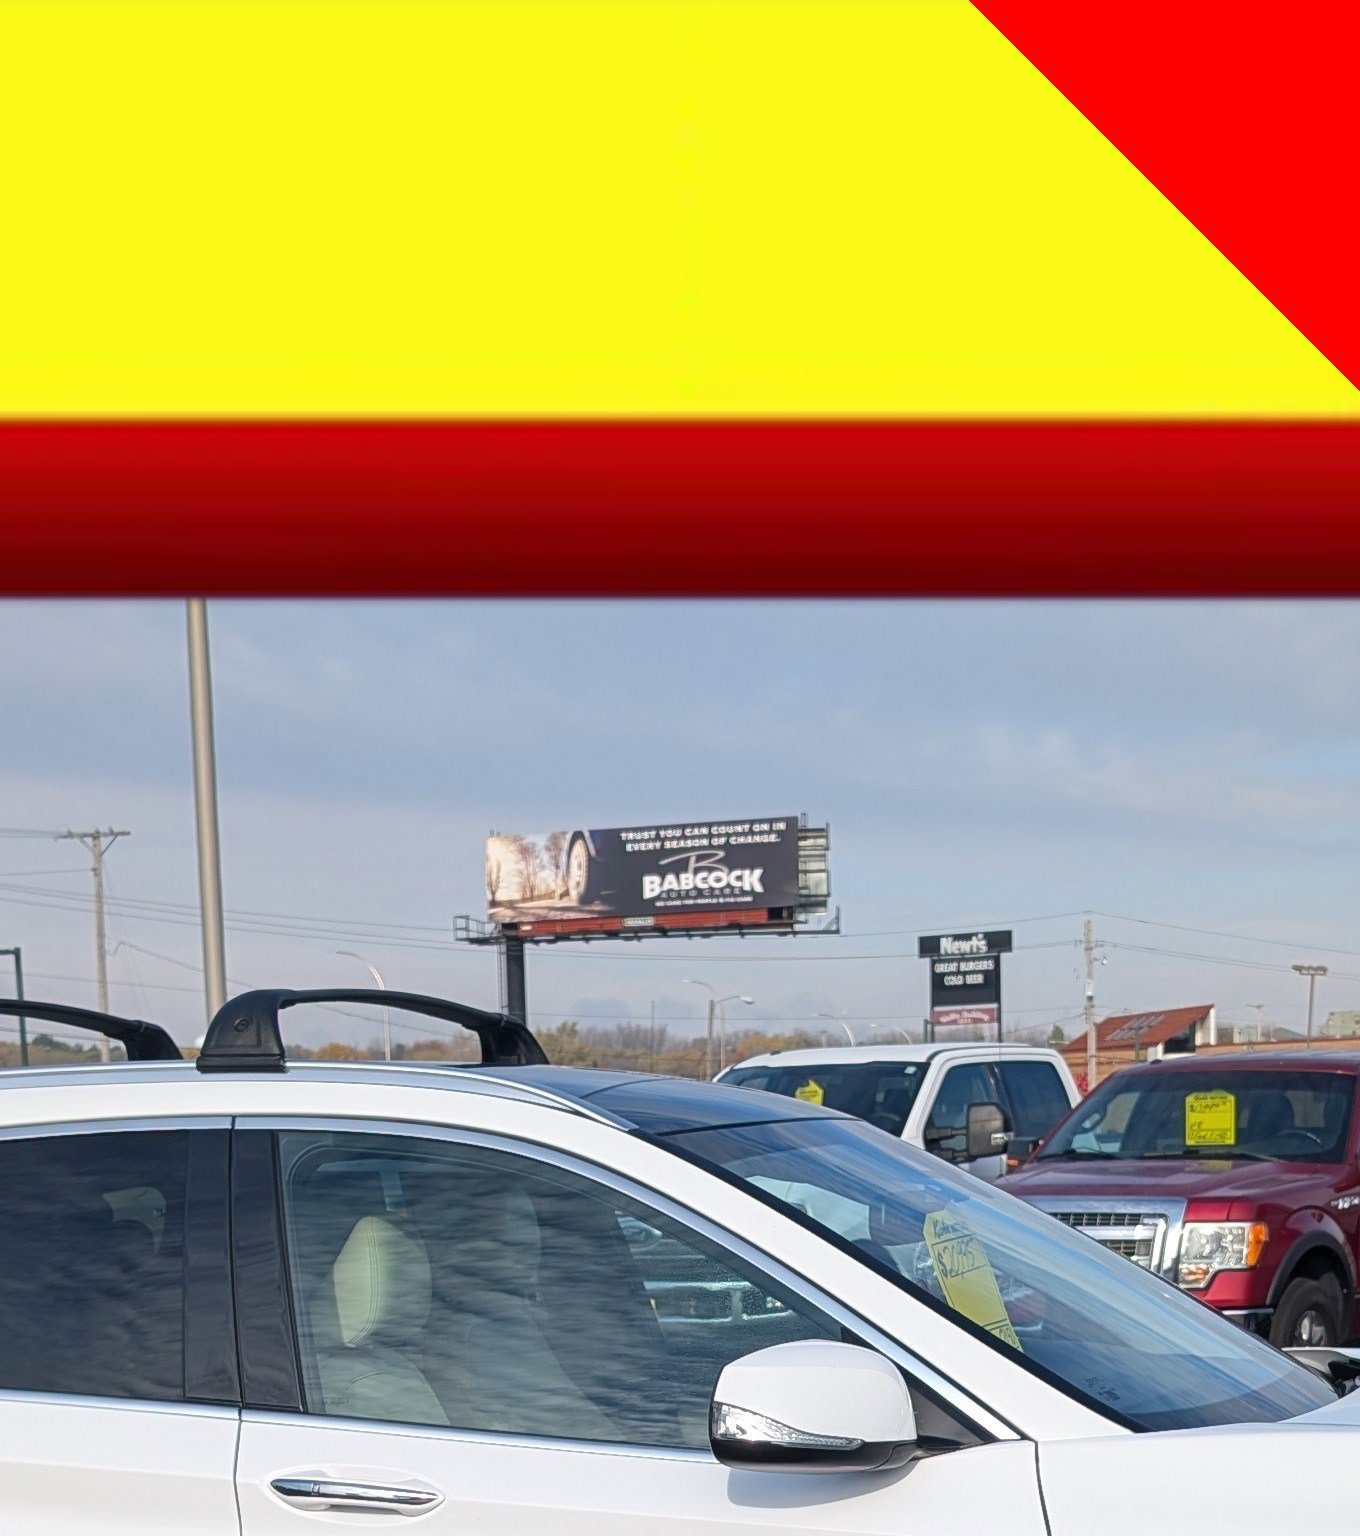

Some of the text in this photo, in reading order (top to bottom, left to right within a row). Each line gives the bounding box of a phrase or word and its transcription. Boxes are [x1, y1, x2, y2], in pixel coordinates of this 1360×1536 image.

[659, 828, 682, 838] YOU
[684, 826, 709, 837] CAN
[711, 824, 750, 835] COUNT
[752, 822, 770, 832] ON
[772, 821, 787, 831] IN
[642, 867, 764, 900] BABCOCK
[940, 933, 988, 955] Newt's
